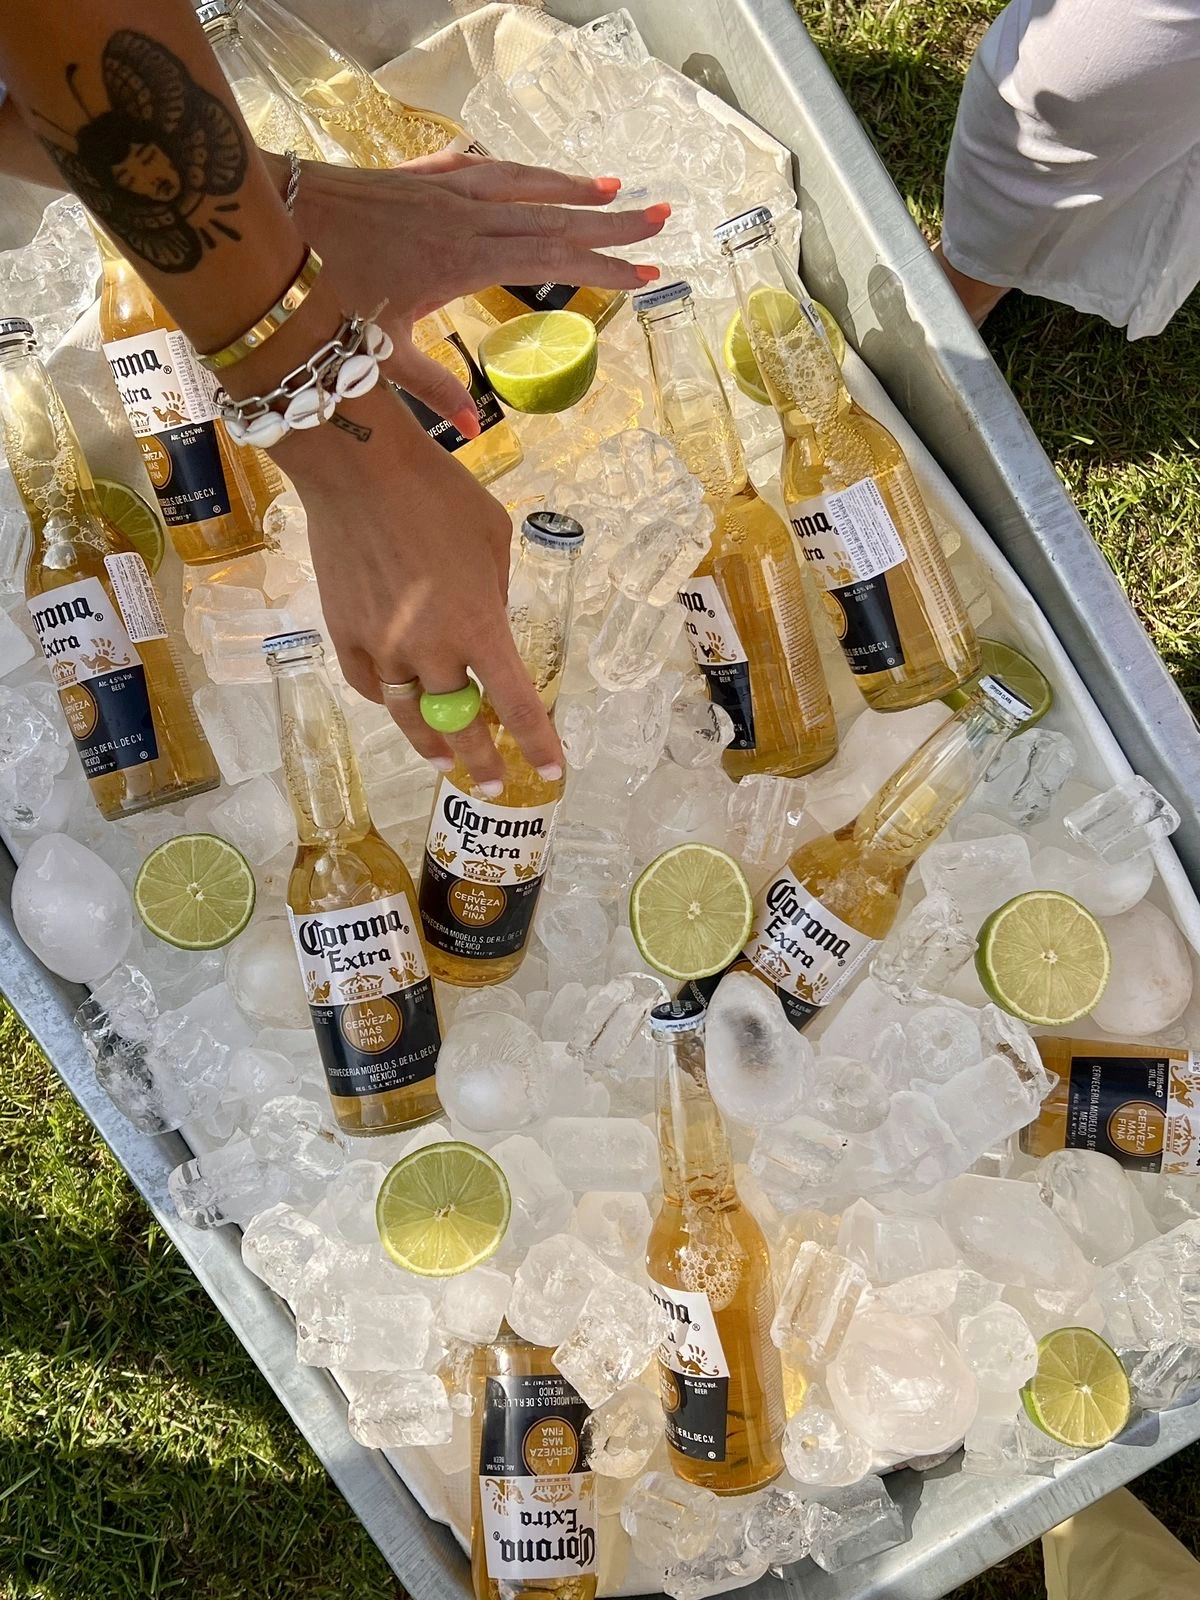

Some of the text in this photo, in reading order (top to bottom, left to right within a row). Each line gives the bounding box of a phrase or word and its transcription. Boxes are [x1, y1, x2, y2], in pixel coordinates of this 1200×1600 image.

[109, 349, 162, 379] rona
[33, 598, 94, 634] orona
[443, 794, 544, 838] Corona
[461, 831, 520, 859] Extra
[454, 891, 500, 906] CERVEZA
[471, 888, 485, 897] LA
[464, 902, 487, 913] MAS
[462, 910, 485, 920] FINA
[766, 879, 850, 959] Corona
[298, 910, 404, 958] Corona
[454, 939, 481, 950] MEXICO
[764, 916, 814, 968] Extra
[326, 948, 391, 973] Extra
[359, 1008, 374, 1018] LA
[345, 1013, 393, 1030] CERVEZA
[359, 1026, 382, 1038] MAS
[360, 1035, 385, 1047] FINA
[399, 1056, 408, 1066] DE
[369, 1069, 397, 1083] MEXICO
[1078, 1111, 1088, 1136] MEXICO
[1117, 1118, 1126, 1140] FINA
[1126, 1119, 1137, 1141] MAS
[1135, 1109, 1147, 1152] CERVEZA
[1147, 1126, 1156, 1139] LA
[539, 1386, 564, 1396] MEXICO
[525, 1397, 535, 1408] DE
[541, 1427, 564, 1436] FINA
[542, 1437, 564, 1447] MAS
[529, 1447, 574, 1457] CERVEZA
[547, 1457, 560, 1467] LA
[519, 1508, 578, 1533] Extra
[499, 1524, 595, 1568] Corona
